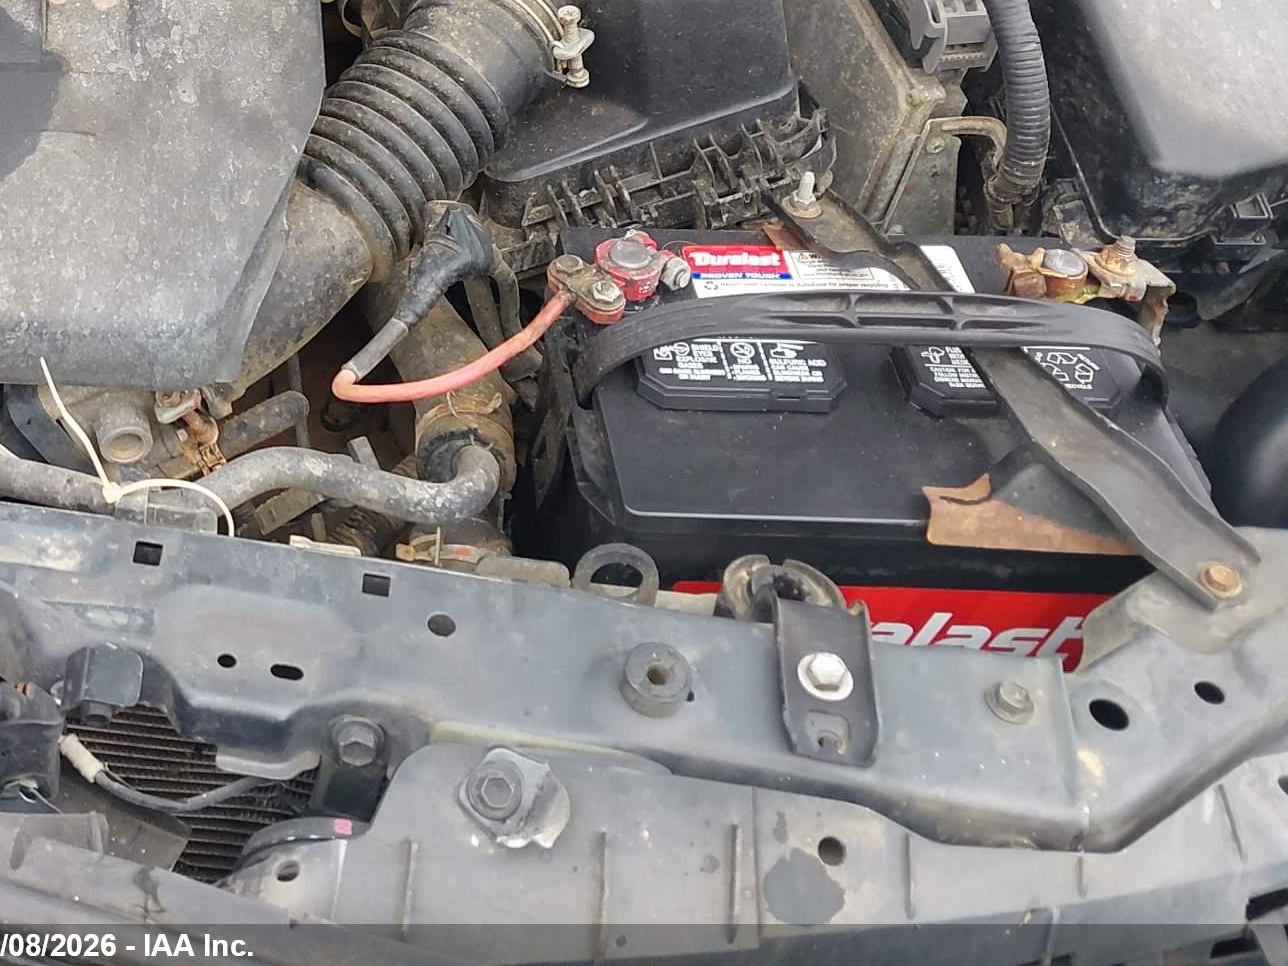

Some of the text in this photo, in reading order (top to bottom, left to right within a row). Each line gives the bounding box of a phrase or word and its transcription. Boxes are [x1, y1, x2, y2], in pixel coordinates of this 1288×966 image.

[689, 251, 781, 267] Duralast
[691, 344, 719, 352] SHIELD
[768, 358, 807, 366] SULFURIC
[871, 612, 1083, 658] alast
